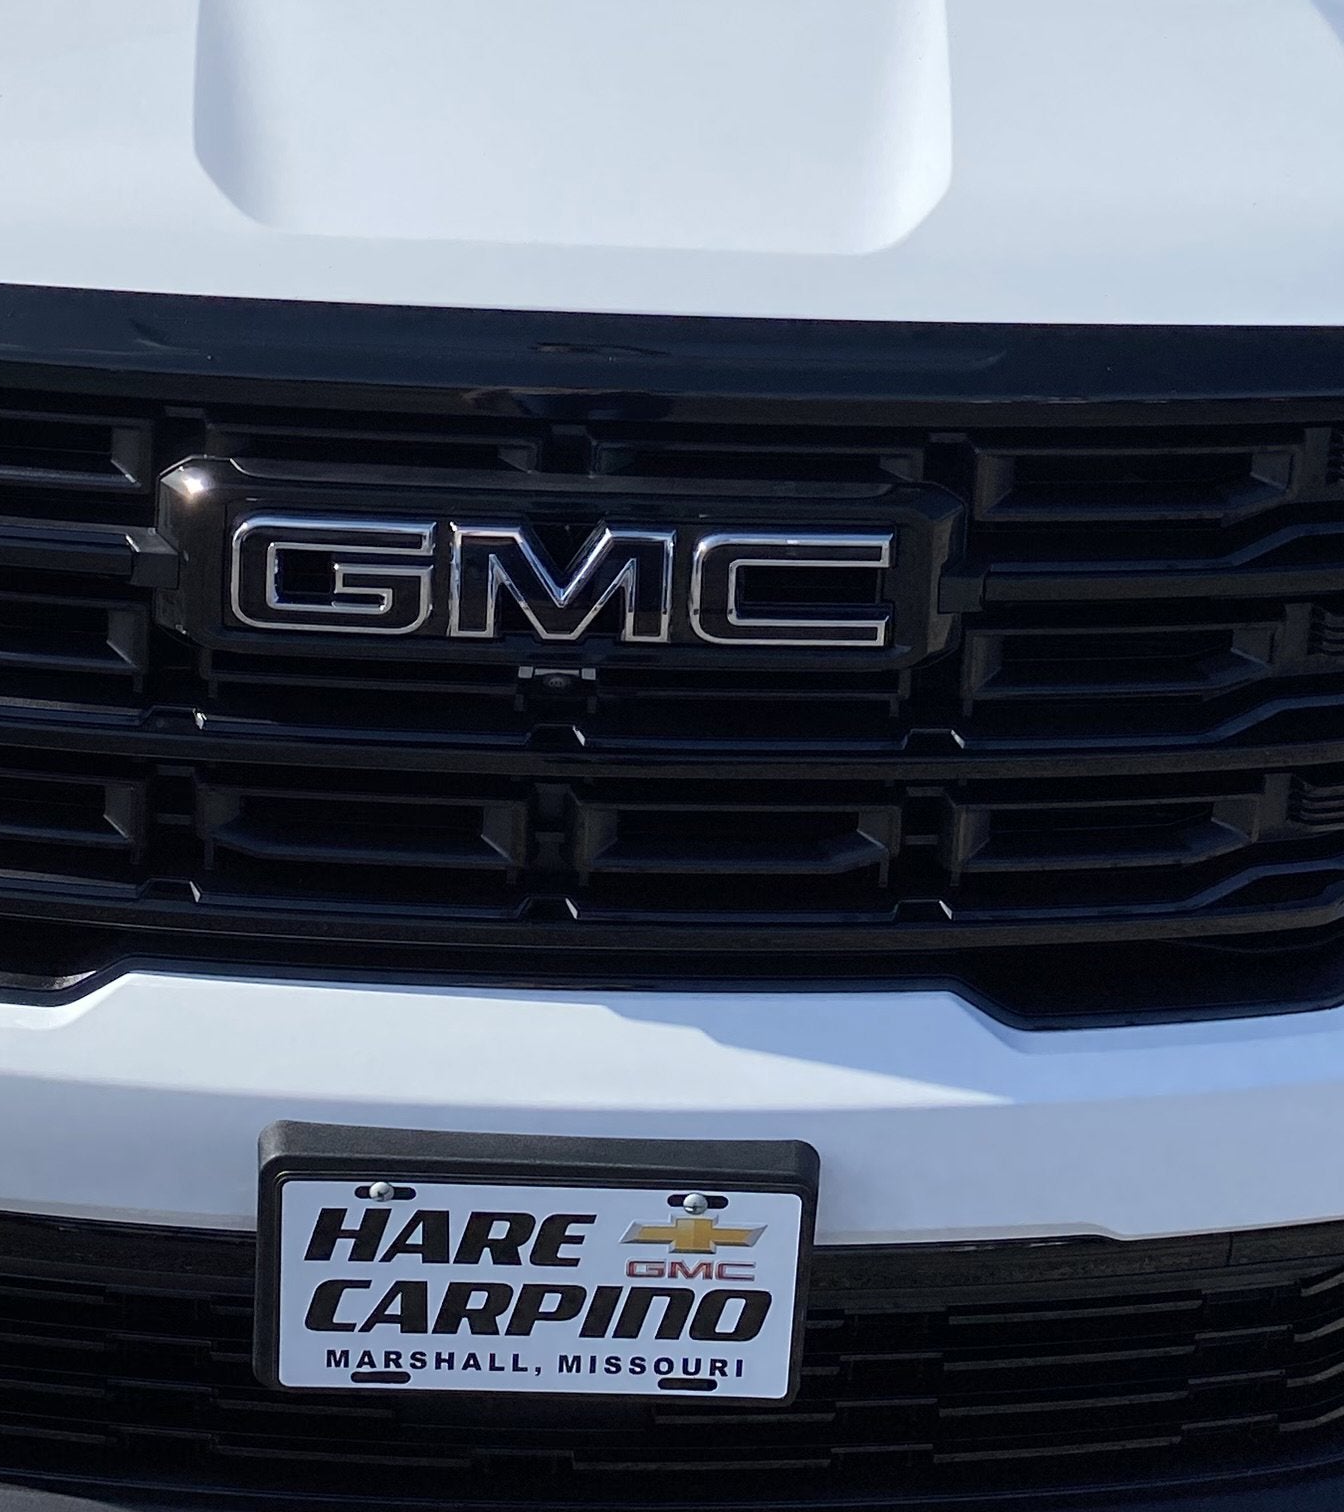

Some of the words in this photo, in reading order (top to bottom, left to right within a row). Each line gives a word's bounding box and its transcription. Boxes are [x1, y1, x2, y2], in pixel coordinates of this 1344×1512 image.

[231, 516, 895, 647] GMC
[303, 1207, 597, 1268] HARE
[625, 1257, 757, 1282] GMC
[303, 1278, 773, 1343] CARPINO
[325, 1348, 542, 1377] MARSHALL,
[558, 1354, 745, 1379] MISSOURI
